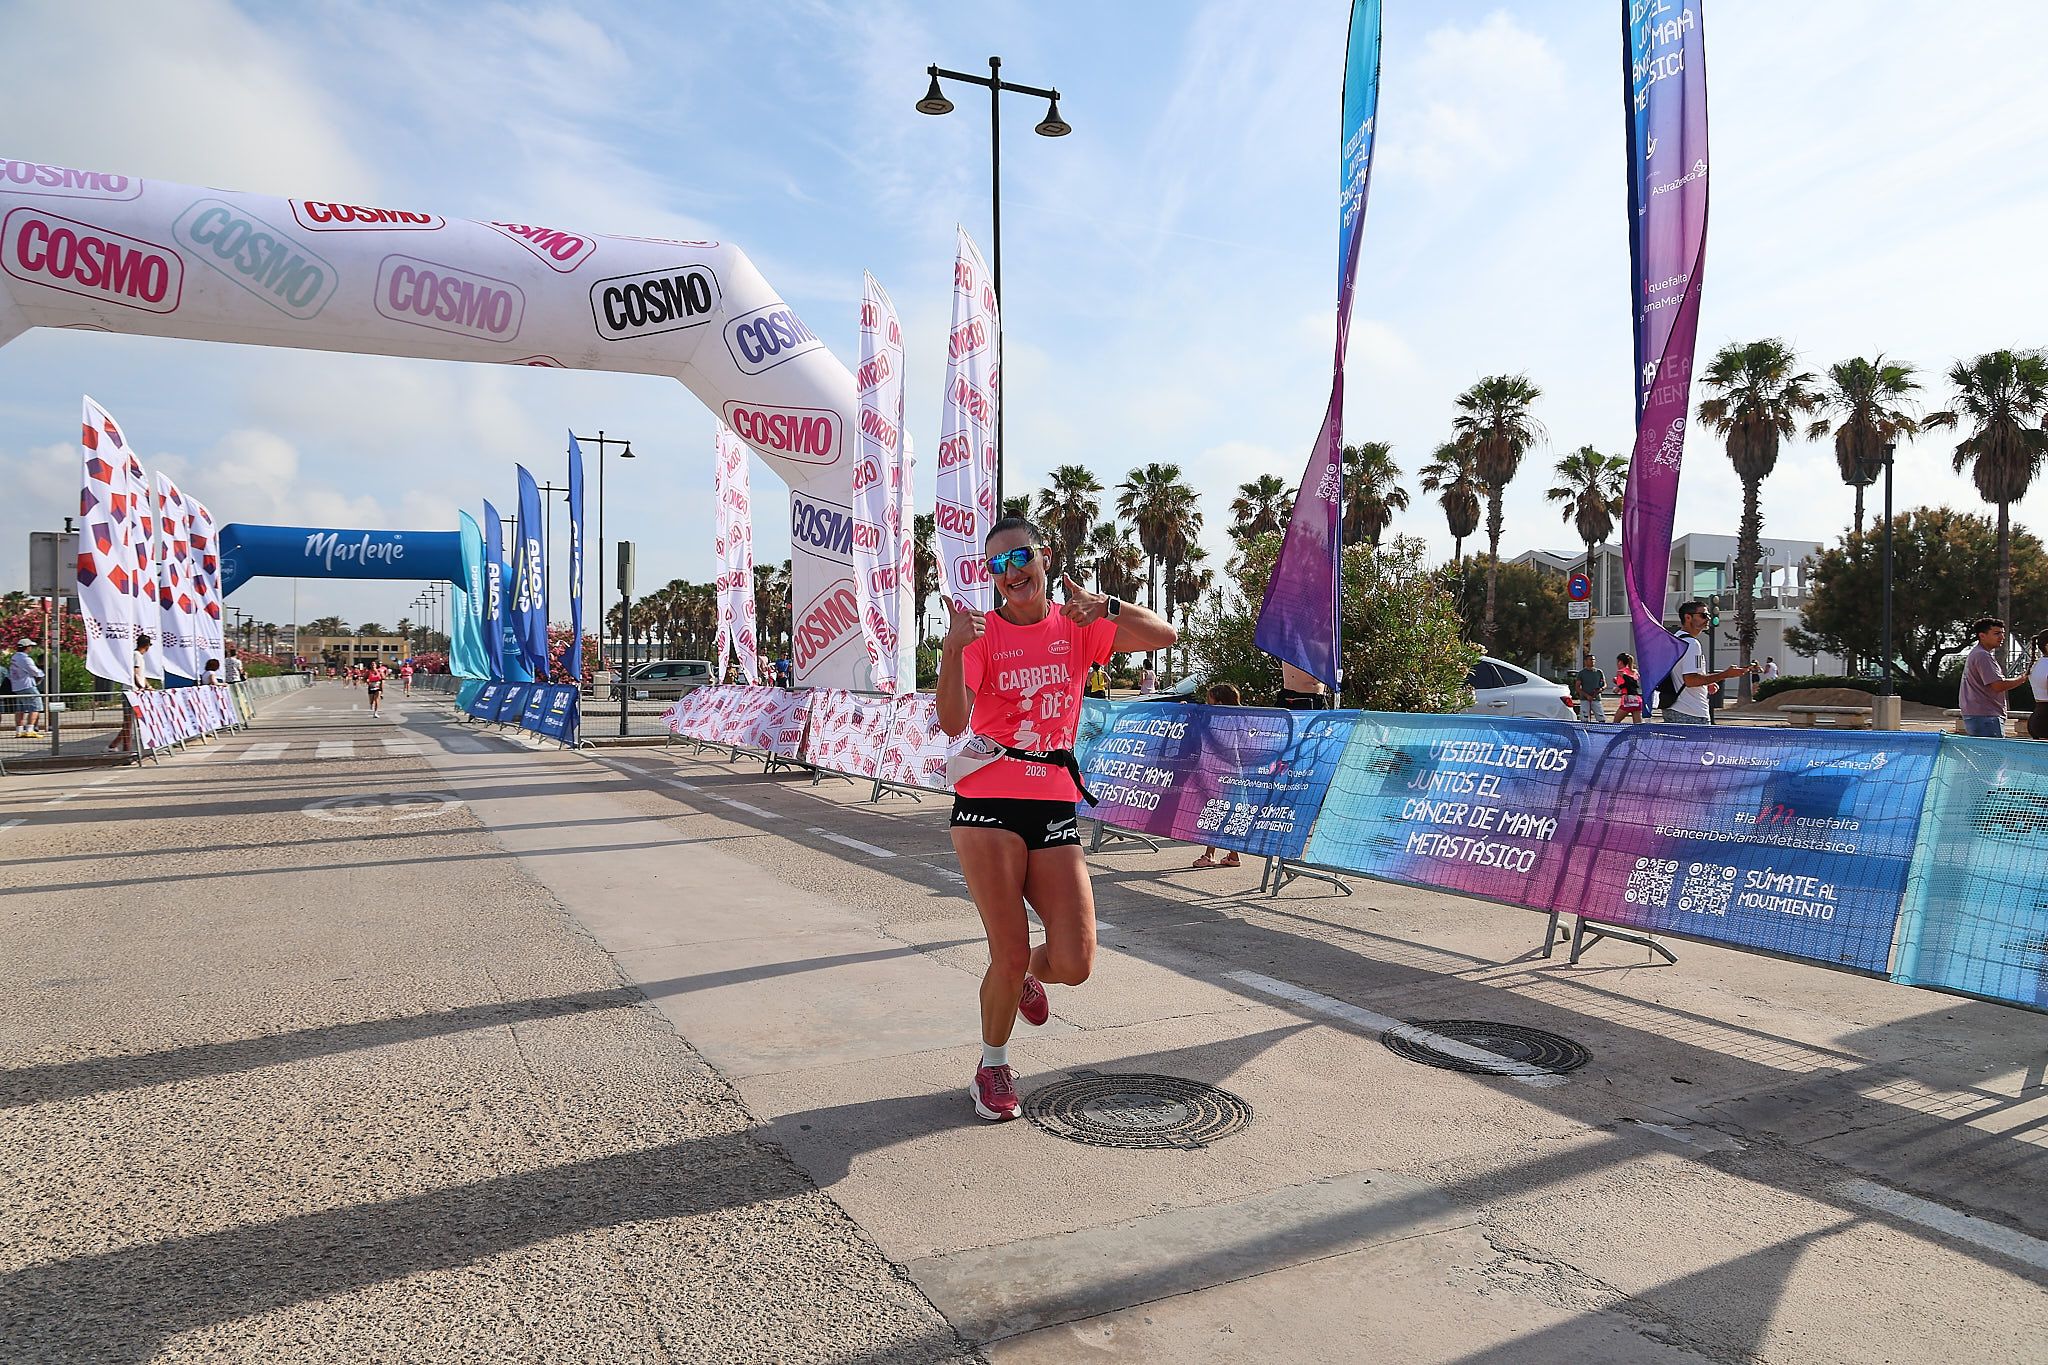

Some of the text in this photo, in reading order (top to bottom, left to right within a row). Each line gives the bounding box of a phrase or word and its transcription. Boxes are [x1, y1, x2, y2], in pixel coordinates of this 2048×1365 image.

[0, 159, 128, 192] OSMO
[17, 220, 168, 303] COSMO
[190, 207, 324, 307] COSMO
[389, 265, 513, 333] COSMO
[603, 272, 712, 331] COSMO
[733, 408, 832, 456] COSMO
[792, 499, 853, 557] COSM
[304, 532, 404, 571] Marlene
[794, 589, 859, 670] COSMO
[992, 648, 1024, 660] OYSHO
[998, 663, 1071, 691] CARRERA
[1131, 740, 1147, 757] EL
[1429, 739, 1573, 772] VISIBILICEMOS
[1717, 754, 1780, 769] Daiichi-Sankyo
[1806, 758, 1872, 771] AstraZeneca
[1025, 765, 1047, 777] 2026
[1087, 754, 1174, 788] CÁNCER DE MAMA
[1407, 769, 1502, 798] JUNTOS EL
[1087, 780, 1160, 811] METASTÁSICO
[1258, 804, 1289, 819] SÚMATE
[1401, 794, 1559, 841] CÁNCER DE MAMA
[1405, 831, 1537, 873] METASTÁSICO
[1743, 867, 1838, 901] SÚMATE AL
[1737, 891, 1834, 921] MOVIMIENTO
